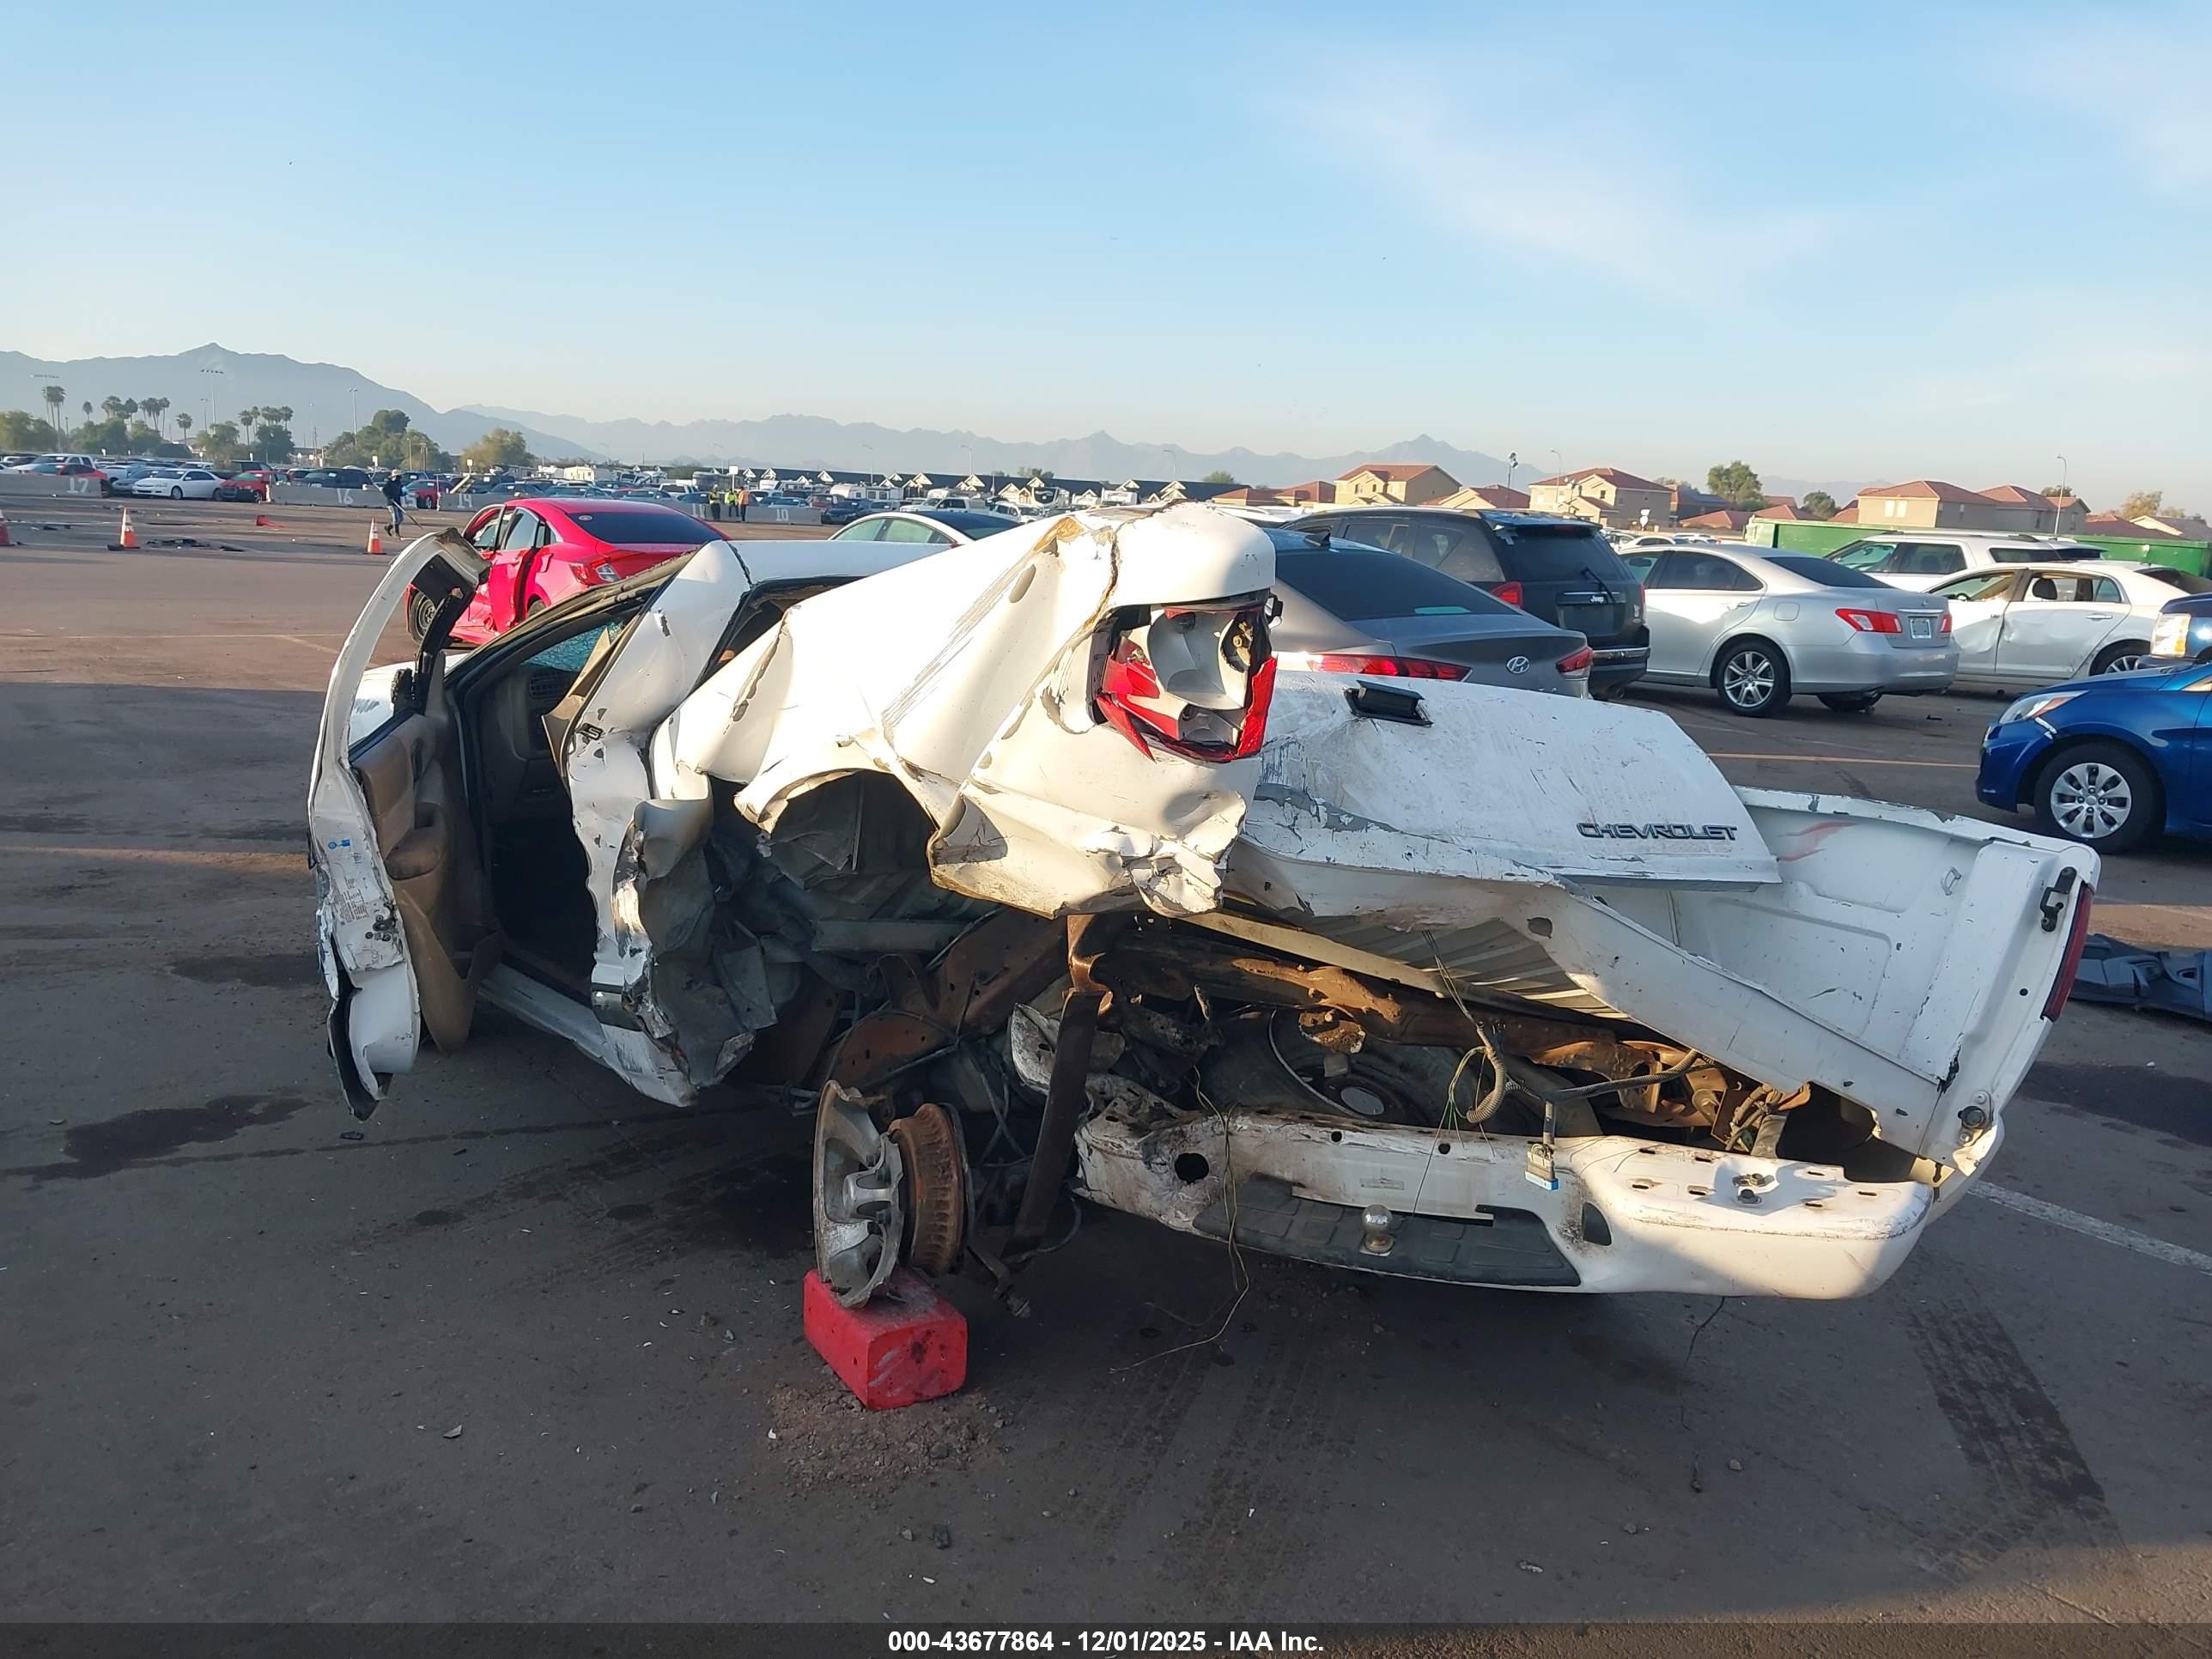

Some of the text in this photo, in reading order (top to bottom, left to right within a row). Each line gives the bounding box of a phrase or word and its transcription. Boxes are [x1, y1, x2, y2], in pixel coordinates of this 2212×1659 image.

[66, 477, 88, 494] 17
[337, 488, 354, 505] 16
[458, 493, 472, 508] 14
[776, 508, 789, 522] 10
[1577, 823, 1738, 841] CHEVROLET
